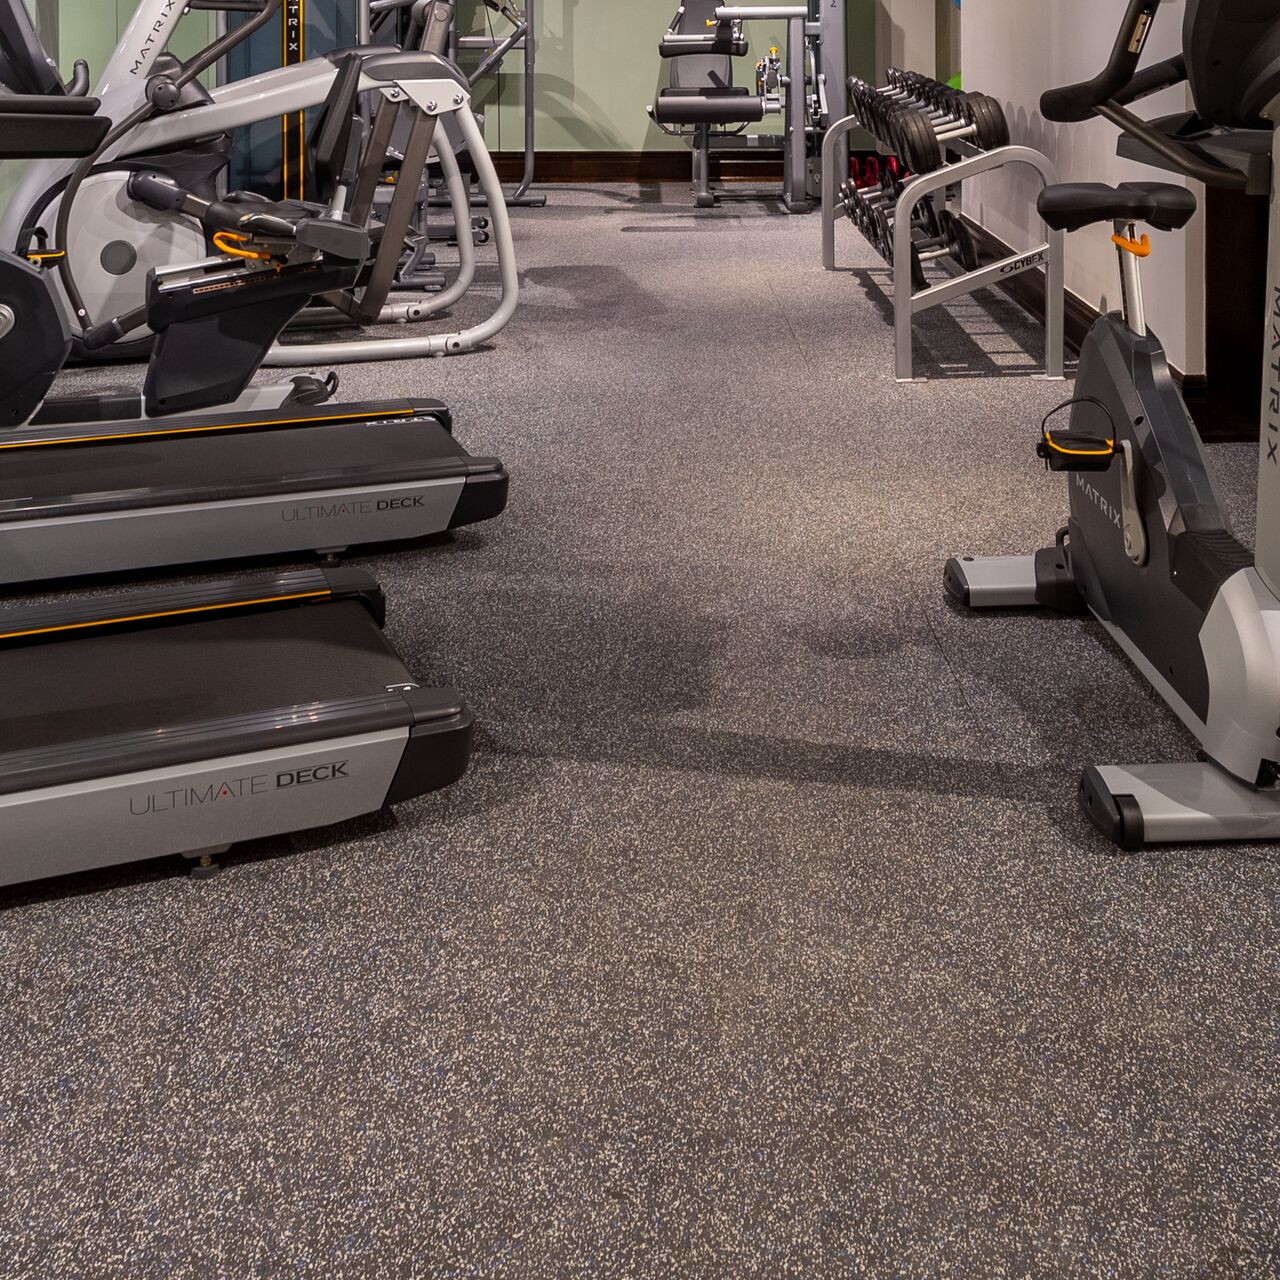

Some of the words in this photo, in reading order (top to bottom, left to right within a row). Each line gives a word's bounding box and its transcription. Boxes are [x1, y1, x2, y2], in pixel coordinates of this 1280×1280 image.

[1014, 252, 1044, 270] CYBEX
[281, 501, 370, 522] ULTIMATE
[376, 495, 426, 512] DECK
[1075, 471, 1121, 529] MATRIX
[129, 774, 269, 816] ULTIMATE
[275, 760, 351, 790] DECK
